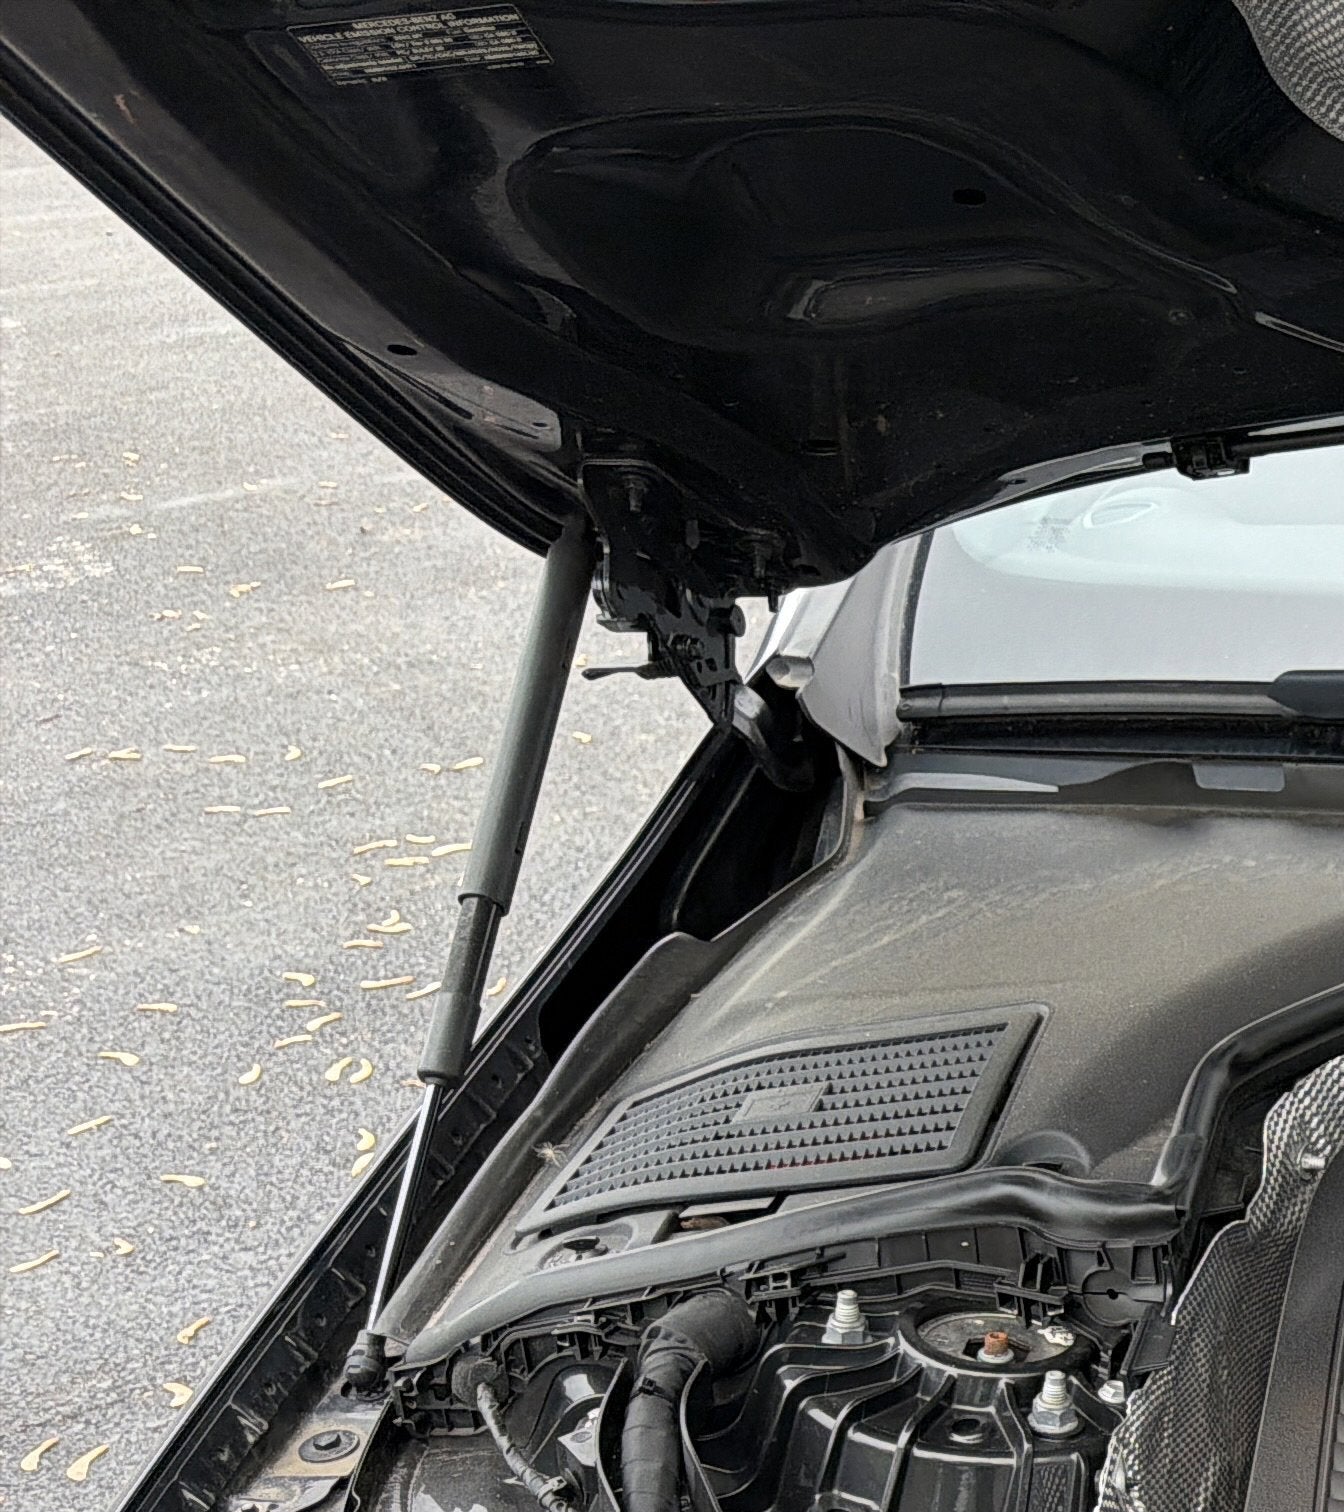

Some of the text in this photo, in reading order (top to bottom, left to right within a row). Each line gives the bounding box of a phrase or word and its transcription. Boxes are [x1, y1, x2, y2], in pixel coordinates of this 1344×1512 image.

[300, 14, 520, 43] VEHICLE EMISSION CONTROL INFORMATION
[352, 15, 437, 30] MERCEDES-BENZ
